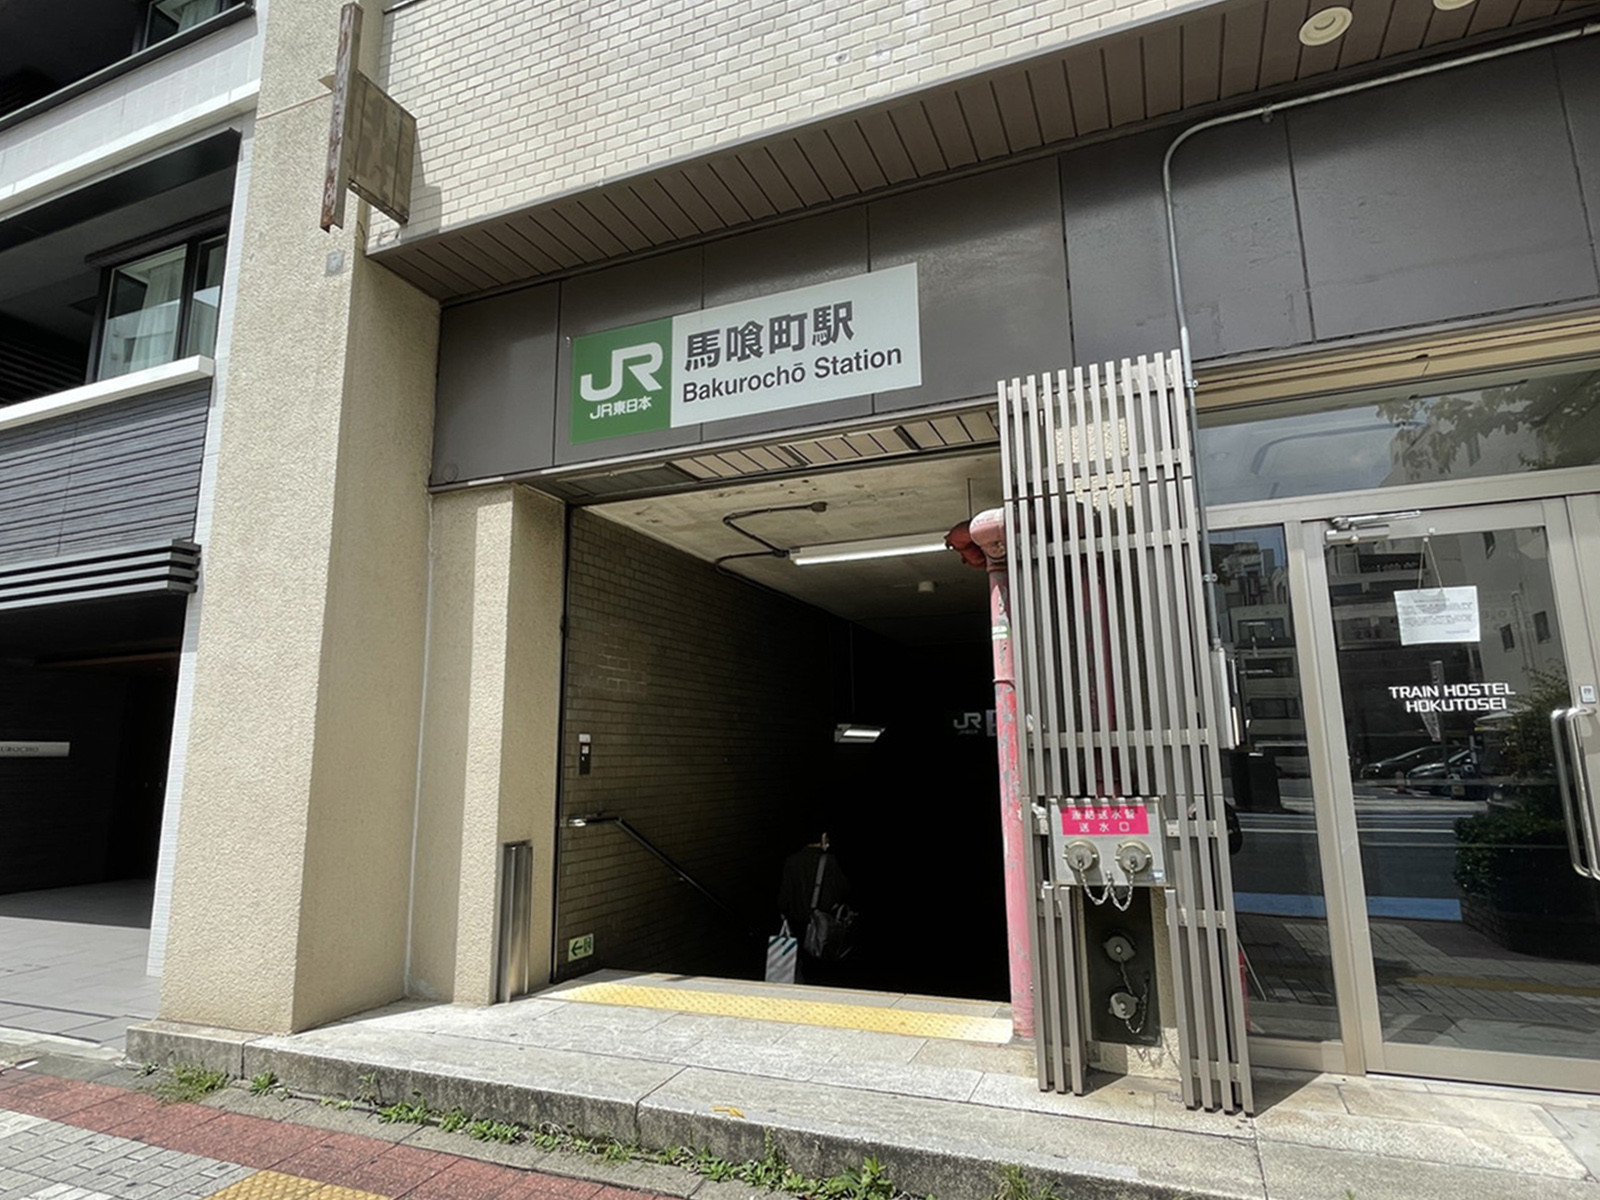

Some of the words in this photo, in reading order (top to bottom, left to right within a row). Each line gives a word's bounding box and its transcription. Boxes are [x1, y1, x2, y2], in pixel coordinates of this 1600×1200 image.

[685, 300, 854, 372] 馬喰町駅
[580, 341, 663, 402] JR
[682, 362, 806, 403] Bakurochō
[814, 347, 902, 379] Station
[590, 395, 652, 420] JR東日本
[1388, 685, 1439, 699] TRAIN
[1443, 683, 1516, 697] HOSTEL
[1405, 697, 1507, 713] HOKUTOSEI
[953, 712, 982, 729] JR
